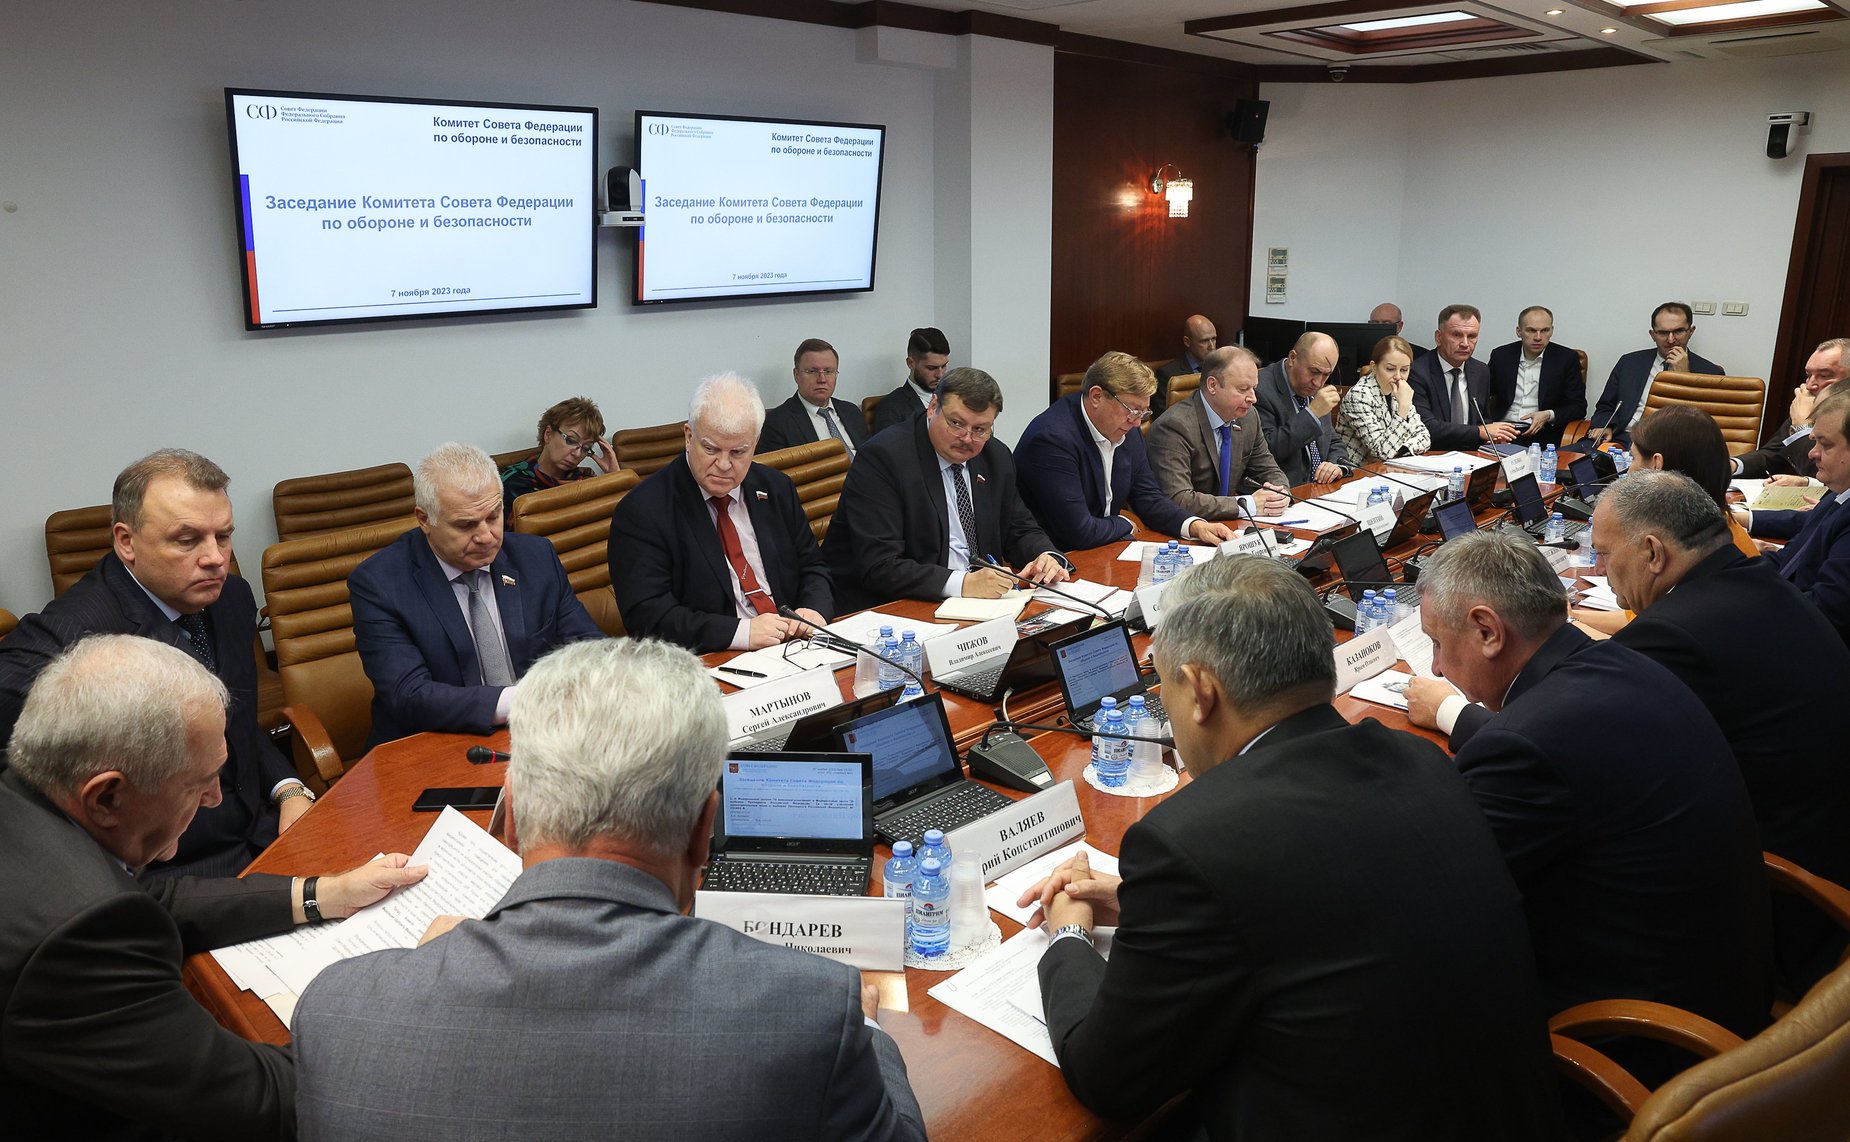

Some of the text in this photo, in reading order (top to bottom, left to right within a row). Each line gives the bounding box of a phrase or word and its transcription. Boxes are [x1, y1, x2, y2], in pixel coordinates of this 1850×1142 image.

[246, 104, 277, 120] СФ
[433, 116, 583, 133] Комитет Совета Федерации
[648, 122, 669, 136] СФ
[433, 132, 582, 147] по обороне и безопасности
[771, 132, 874, 146] Комитет Совета Федерации
[771, 146, 781, 154] по
[783, 145, 816, 156] обороне
[823, 147, 873, 158] безопасности
[265, 195, 574, 212] Заседание Комитета Совета Федерации
[654, 195, 863, 210] Заседание Комитета Совета Федерации
[322, 215, 532, 232] по обороне и безопасности
[690, 212, 833, 226] по обороне и безопасности
[398, 289, 430, 297] ноября
[431, 287, 451, 295] 2023
[452, 287, 471, 295] года
[956, 636, 988, 652] ЧИЖОВ
[948, 654, 974, 666] Владимир
[1345, 640, 1382, 666] КАЗАНОКОВ
[749, 691, 811, 718] МАРТЫНОВ
[742, 702, 826, 734] Сергей Александрович
[999, 811, 1046, 842] ВАЛЯЕВ
[981, 814, 1083, 875] рий Константинович
